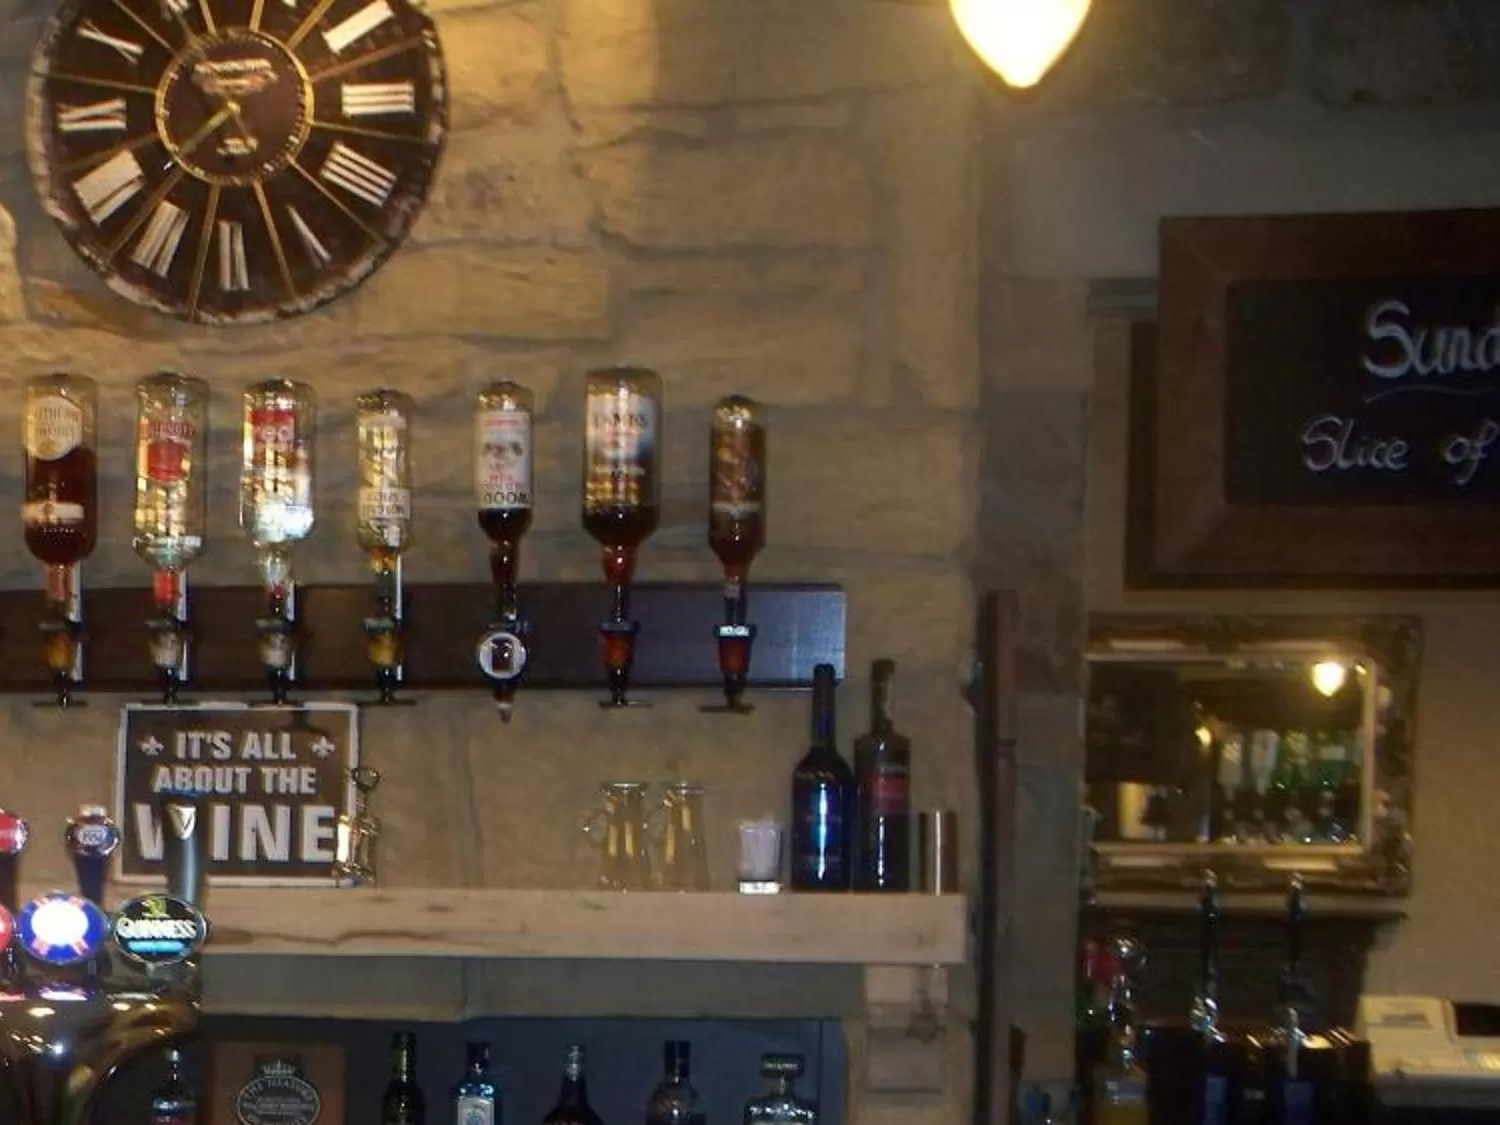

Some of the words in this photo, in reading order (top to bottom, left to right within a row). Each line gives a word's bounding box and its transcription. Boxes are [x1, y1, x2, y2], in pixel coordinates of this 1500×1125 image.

[341, 82, 414, 117] III
[1301, 414, 1412, 472] Slice
[1444, 418, 1500, 486] of
[174, 730, 232, 760] IT'S
[241, 731, 297, 760] ALL
[153, 765, 252, 794] ABOUT
[260, 766, 317, 795] THE
